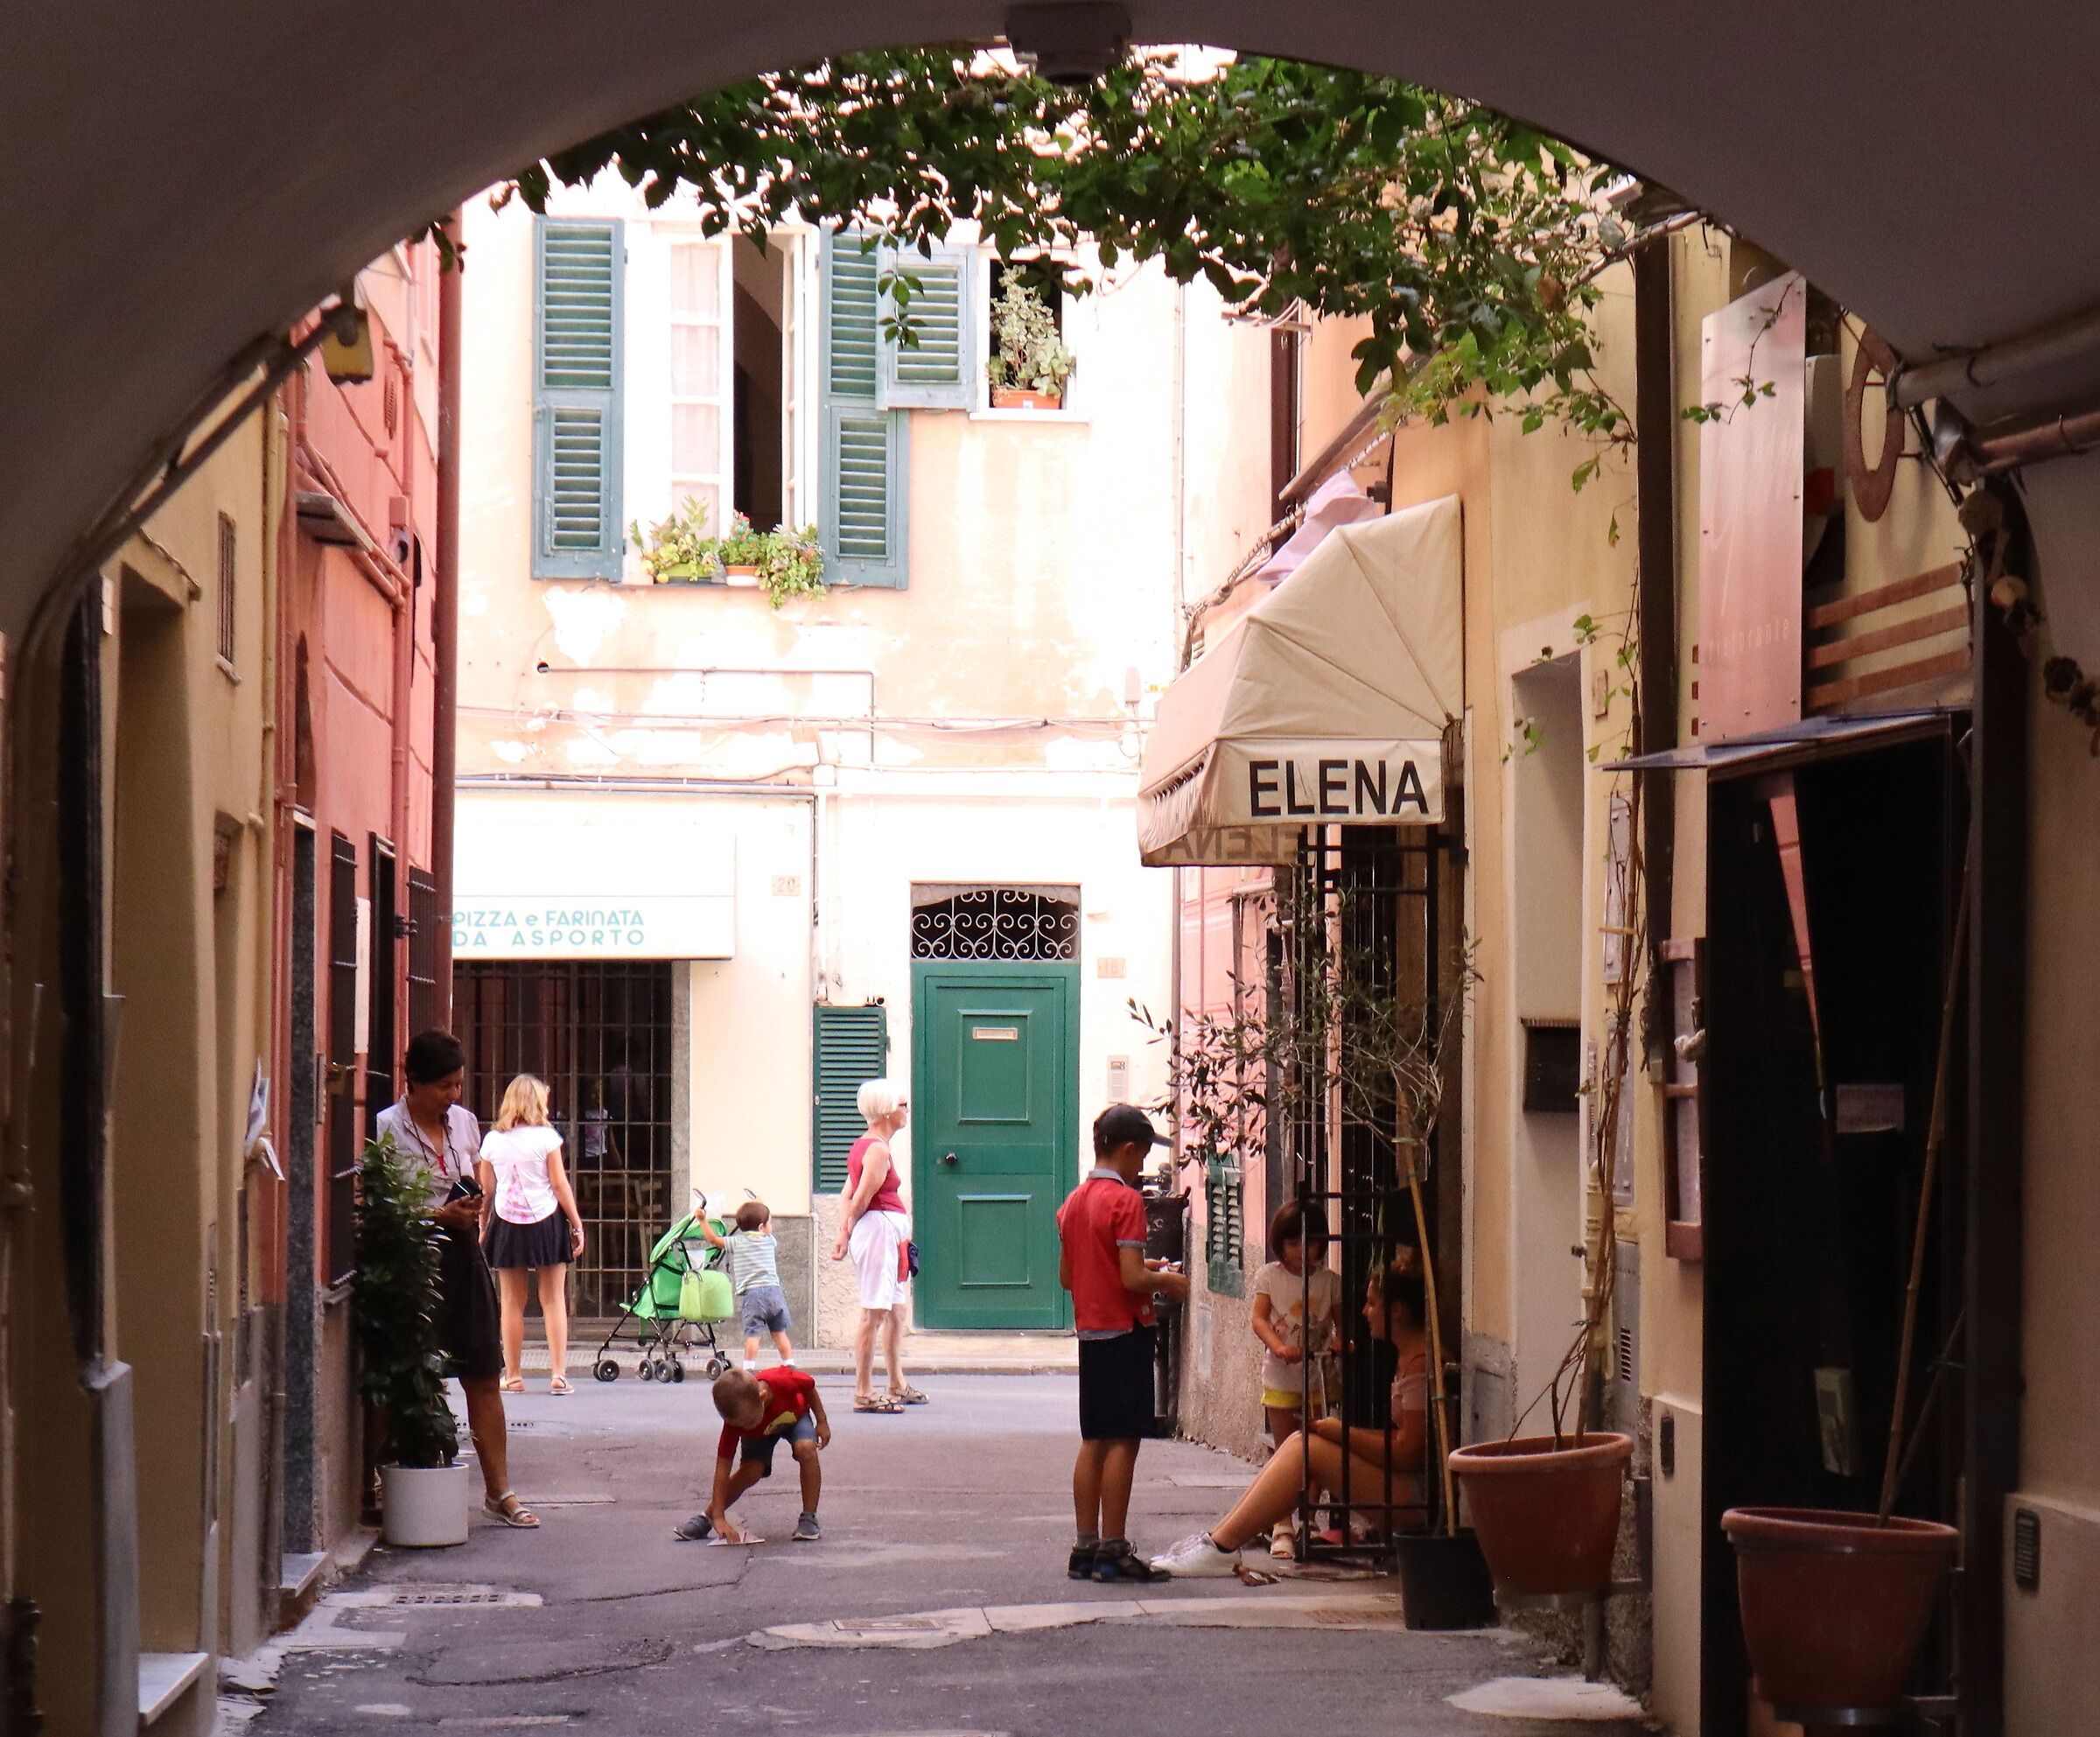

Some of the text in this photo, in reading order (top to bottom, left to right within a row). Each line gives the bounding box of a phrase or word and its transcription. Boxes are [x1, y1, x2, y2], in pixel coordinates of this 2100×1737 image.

[1249, 759, 1430, 816] ELENA
[777, 875, 795, 893] 20
[452, 910, 644, 928] PIZZA e FARINATA
[452, 929, 644, 947] DA ASPORTO
